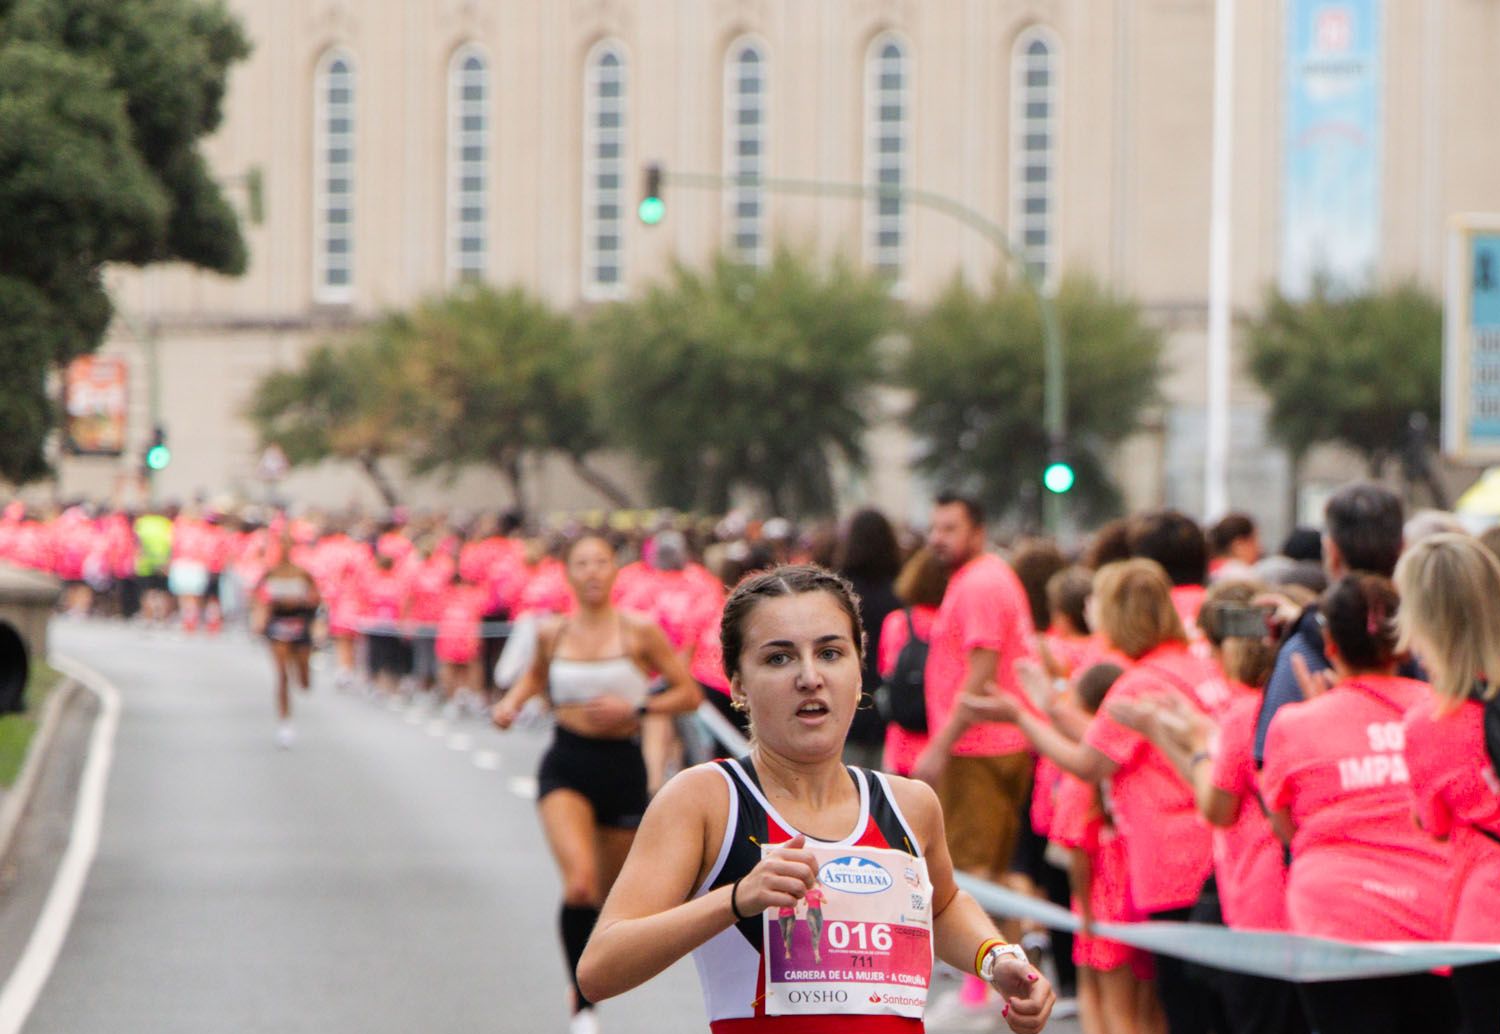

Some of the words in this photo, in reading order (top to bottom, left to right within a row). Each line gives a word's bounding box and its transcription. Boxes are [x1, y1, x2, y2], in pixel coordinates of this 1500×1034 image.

[825, 868, 888, 886] ASTURIANA
[828, 921, 893, 951] 016
[851, 955, 873, 967] 711
[784, 970, 826, 980] CARRERA
[828, 970, 841, 980] DE
[842, 970, 855, 980] LA
[856, 971, 885, 981] MUJER
[898, 974, 927, 986] CORUÑA
[788, 990, 848, 1004] OYSHO
[883, 993, 928, 1007] Santande
